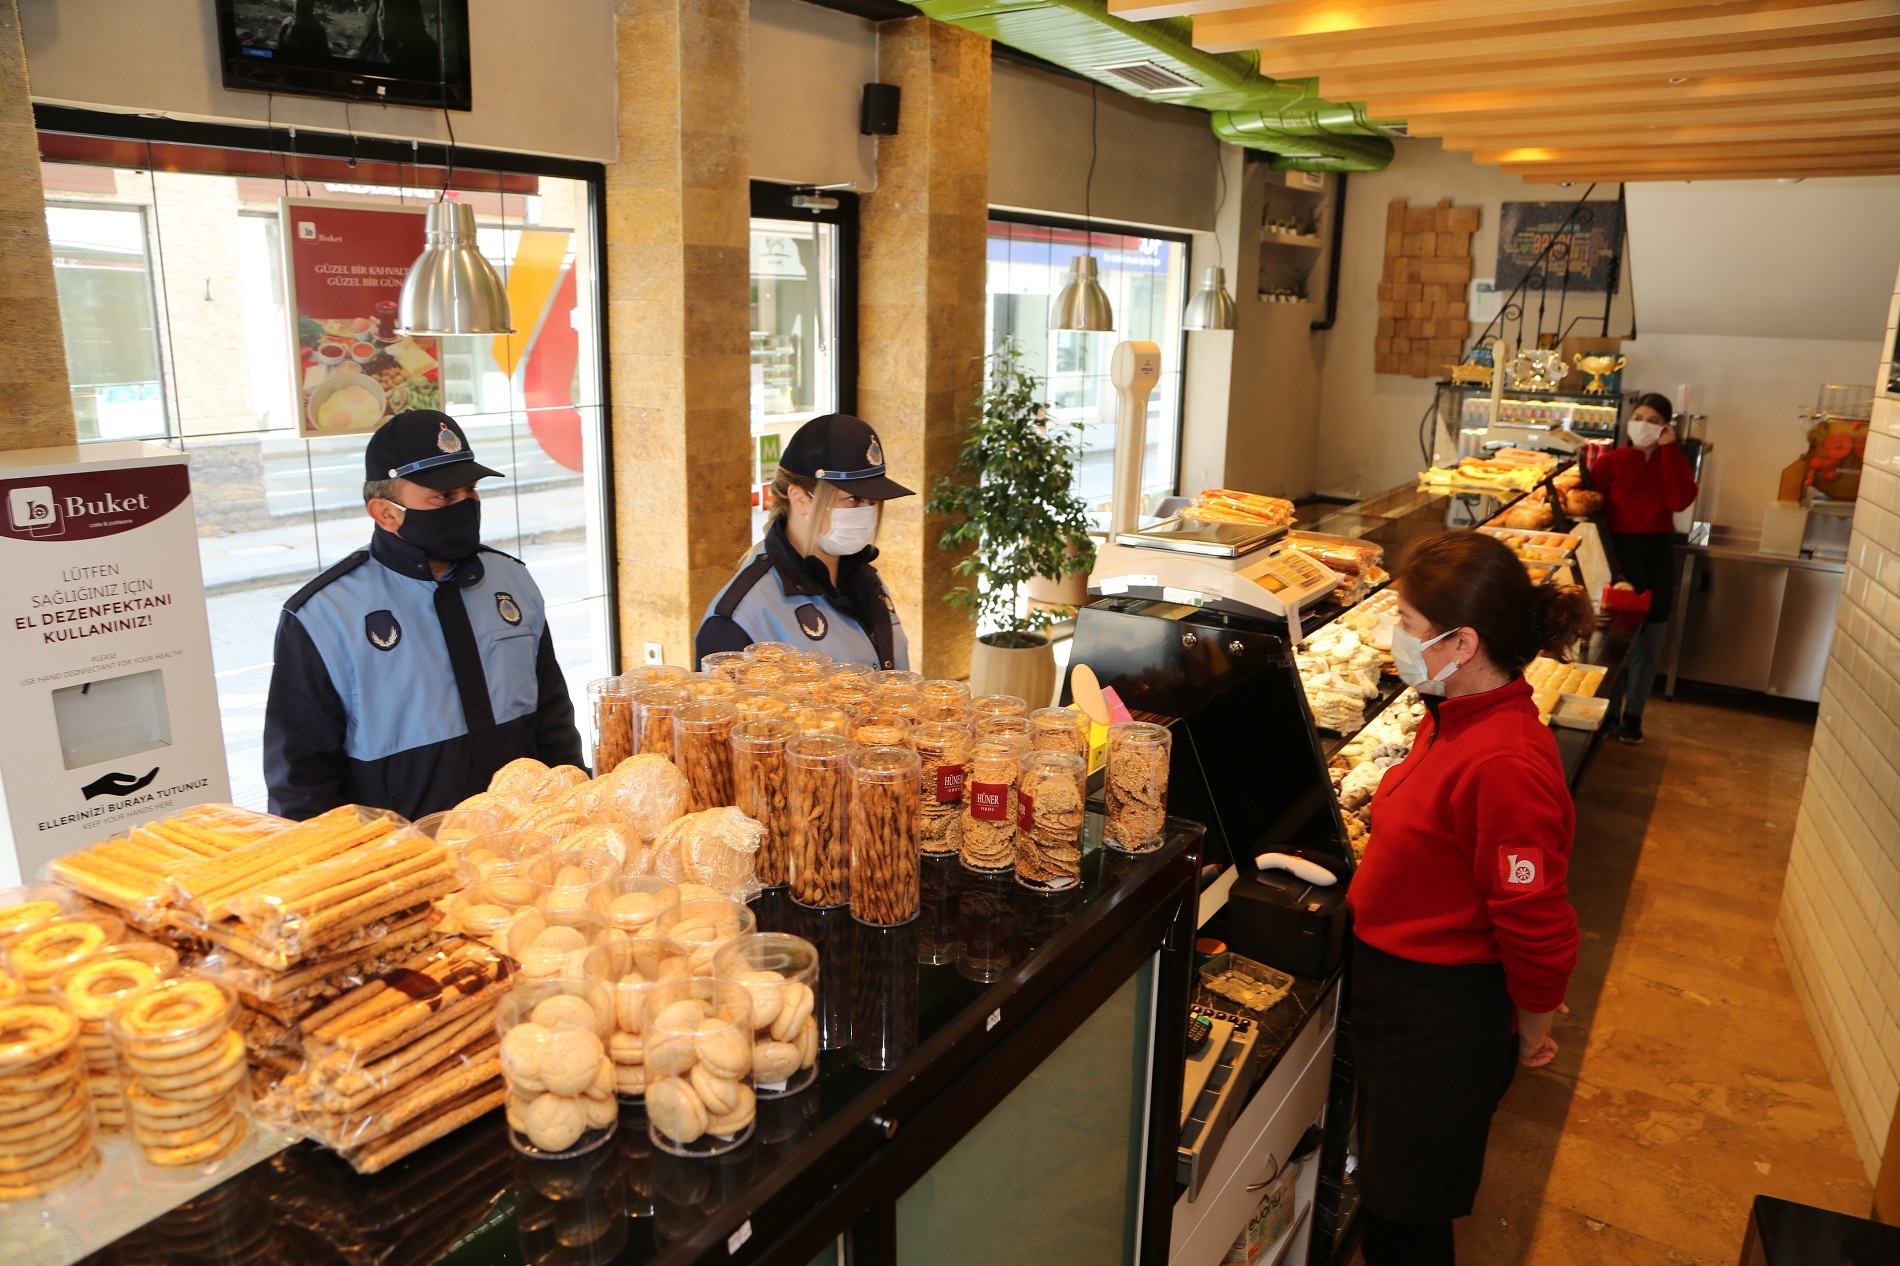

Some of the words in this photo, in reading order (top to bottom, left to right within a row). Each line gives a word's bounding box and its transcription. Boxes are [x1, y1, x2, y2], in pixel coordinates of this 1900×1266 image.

[314, 263, 350, 274] GÜZEL
[351, 264, 368, 275] BİR
[368, 266, 411, 276] KAHVALT
[327, 275, 361, 286] GÜZEL
[362, 276, 379, 287] BİR
[762, 438, 779, 460] M
[62, 492, 151, 519] Buket
[61, 563, 120, 583] LÜTFEN
[31, 583, 119, 609] SAĞLIĞINIZ
[123, 578, 153, 597] İÇİN
[15, 616, 38, 630] EL
[42, 593, 172, 626] DEZENFEKTANI
[43, 614, 153, 644] KULLANINIZ!
[20, 677, 37, 687] USE
[38, 673, 62, 683] HAND
[63, 662, 116, 678] DISINFECTANT
[118, 659, 132, 668] FOR
[134, 655, 154, 666] YOUR
[155, 649, 184, 660] HEALTH!
[91, 653, 118, 663] PLEASE
[38, 804, 105, 831] ELLERİNİZİ
[108, 793, 154, 813] BURAYA
[157, 778, 209, 799] TUTUNUZ
[977, 792, 999, 805] HÜNER
[83, 820, 103, 831] KEEP
[104, 814, 125, 825] YOUR
[127, 806, 154, 818] HANDS
[155, 799, 174, 809] HERE
